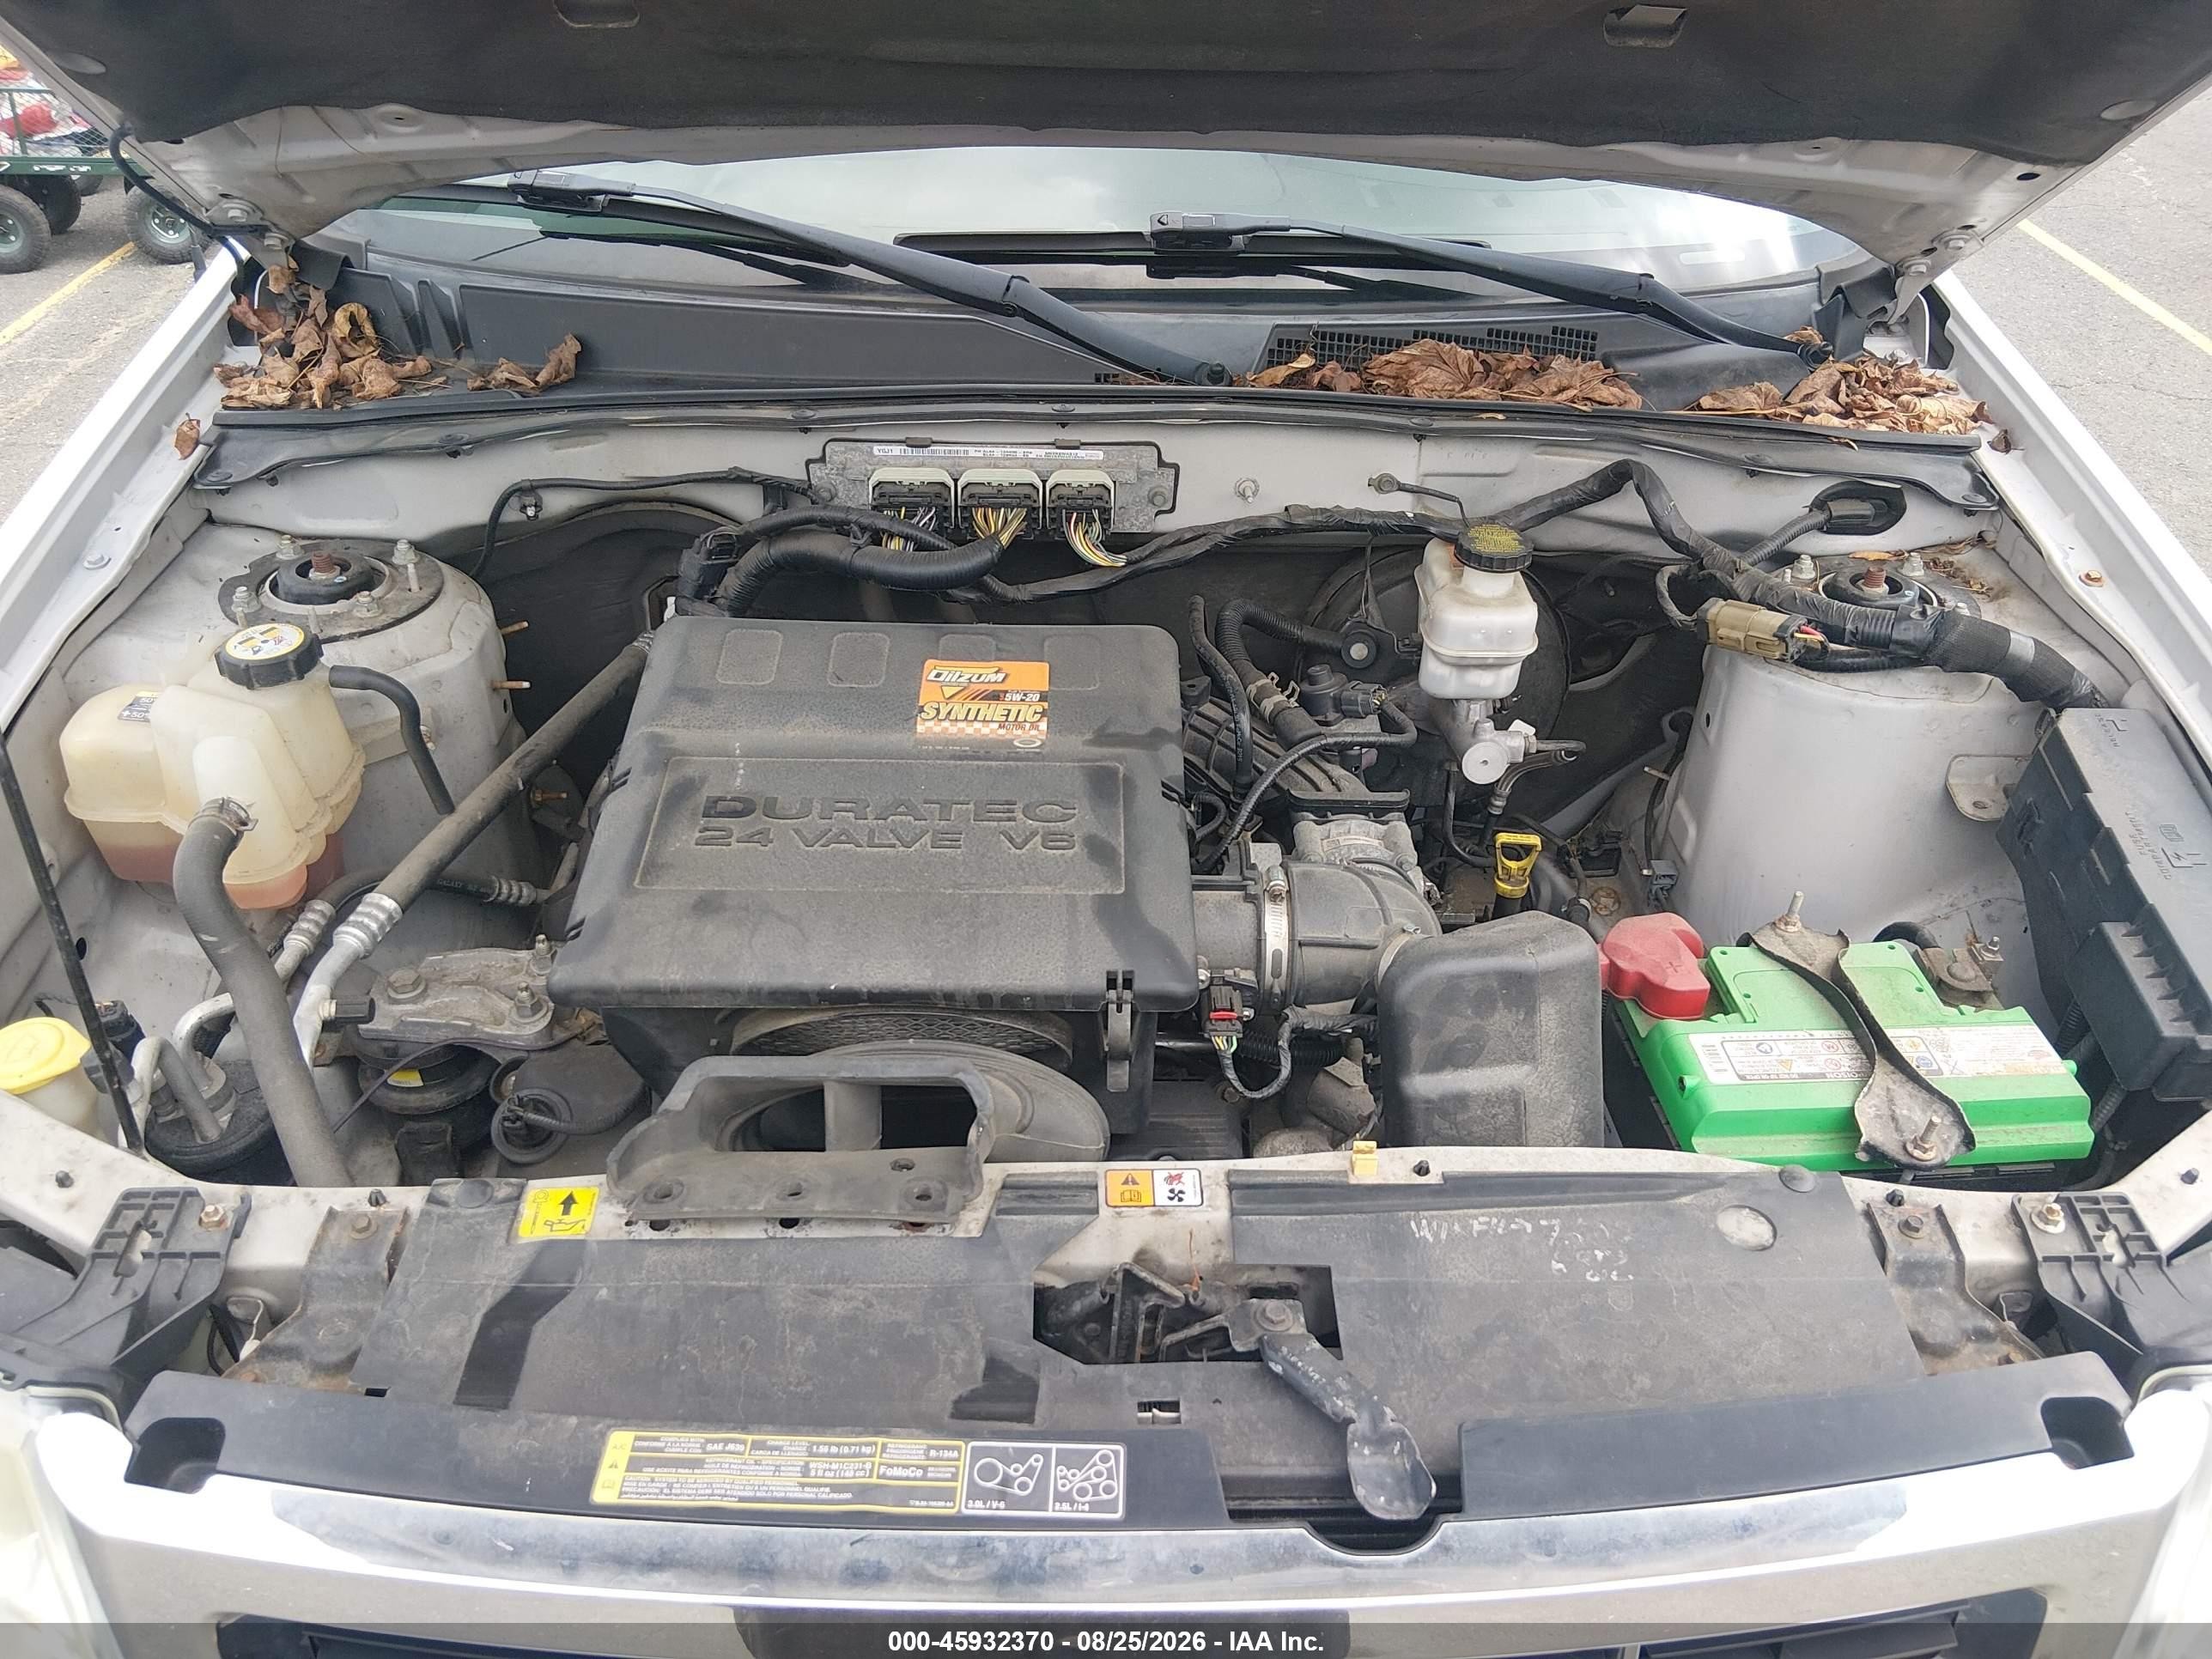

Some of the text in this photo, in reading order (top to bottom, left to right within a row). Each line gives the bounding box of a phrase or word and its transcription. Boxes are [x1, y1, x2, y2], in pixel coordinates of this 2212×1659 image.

[1004, 692, 1041, 702] 5W-20
[920, 702, 1044, 723] SYNTHETIC
[701, 794, 1078, 823] DURATEC
[694, 825, 1077, 851] 24 VALVE V6
[929, 1449, 959, 1458] R-134A
[879, 1465, 924, 1478] FoMoCo
